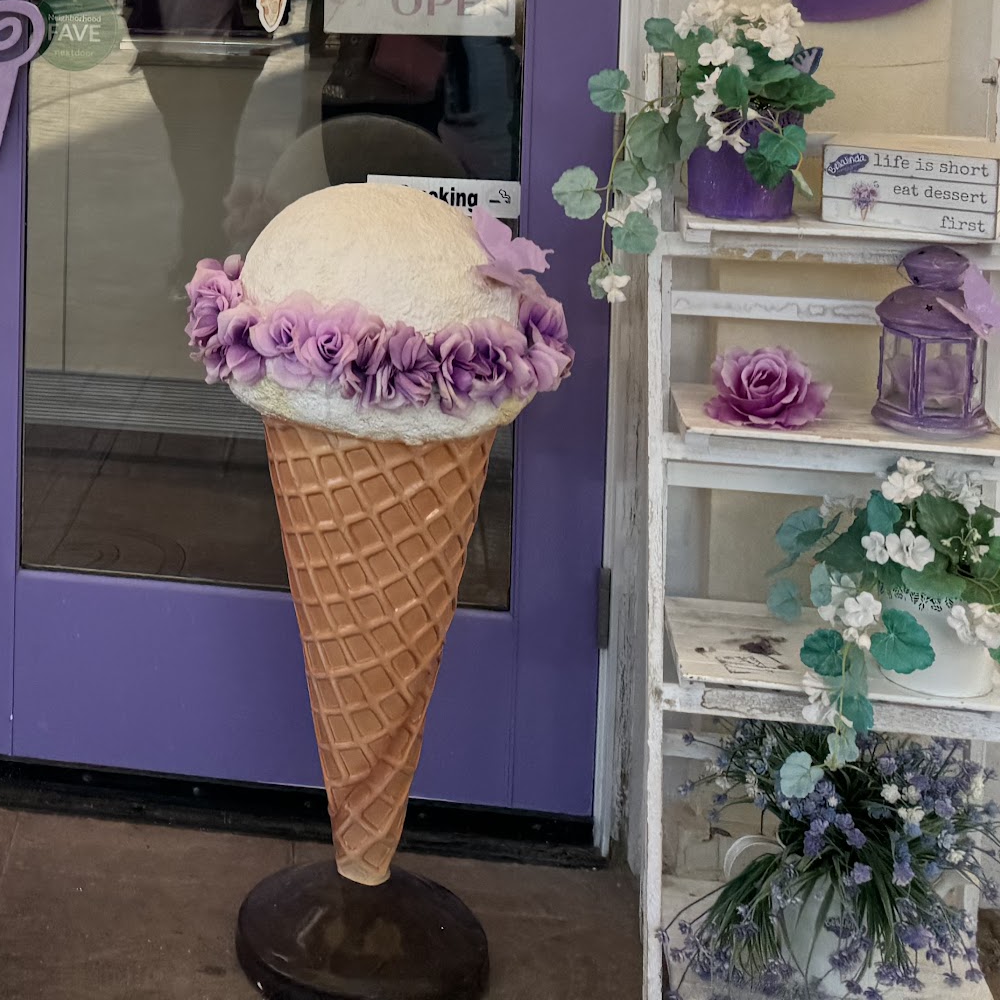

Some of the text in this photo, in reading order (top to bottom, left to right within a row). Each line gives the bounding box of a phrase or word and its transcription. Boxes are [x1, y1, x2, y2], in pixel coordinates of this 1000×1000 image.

[48, 14, 102, 23] Neighborhood
[47, 23, 101, 43] FAVE
[873, 153, 910, 169] life
[915, 158, 934, 172] is
[939, 160, 990, 178] short
[893, 184, 988, 204] eat dessert
[940, 215, 986, 233] first
